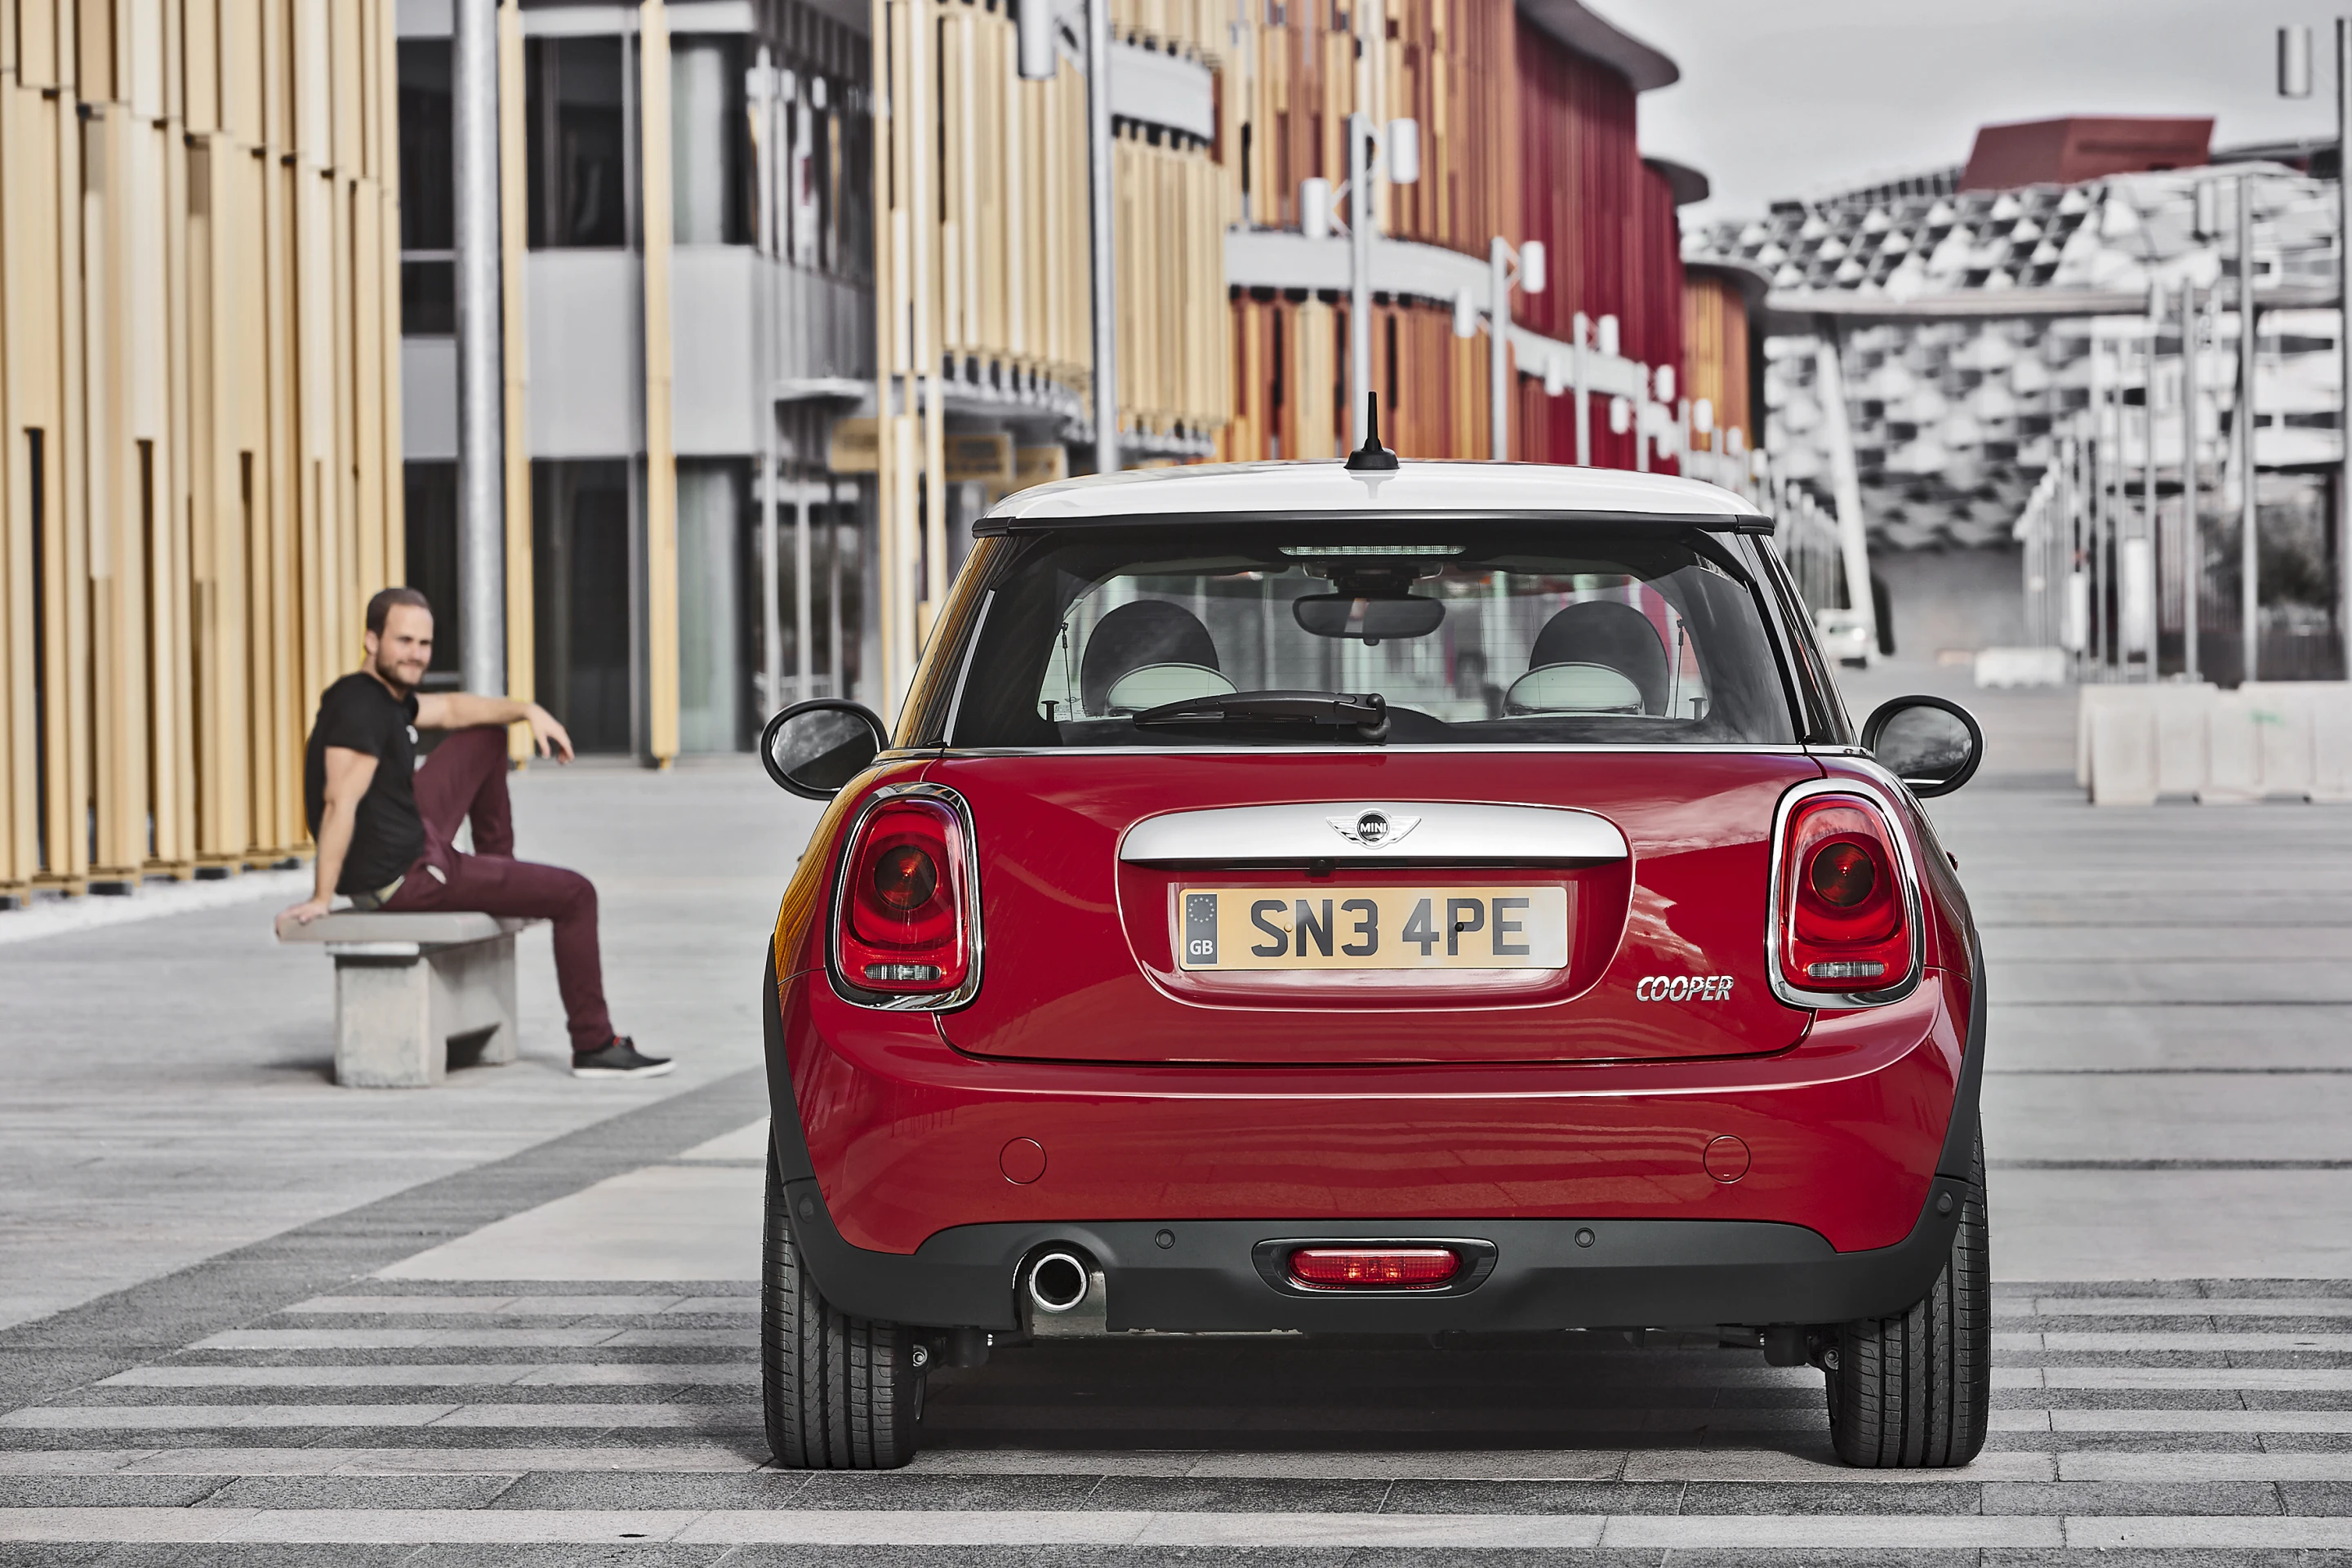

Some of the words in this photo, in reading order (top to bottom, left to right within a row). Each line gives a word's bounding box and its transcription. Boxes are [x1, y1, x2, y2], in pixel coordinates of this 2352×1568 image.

[1360, 822, 1388, 834] MINI
[1250, 898, 1379, 957] SN3
[1402, 898, 1530, 956] 4PE
[1190, 939, 1214, 956] GB
[1636, 975, 1734, 1002] COOPER
